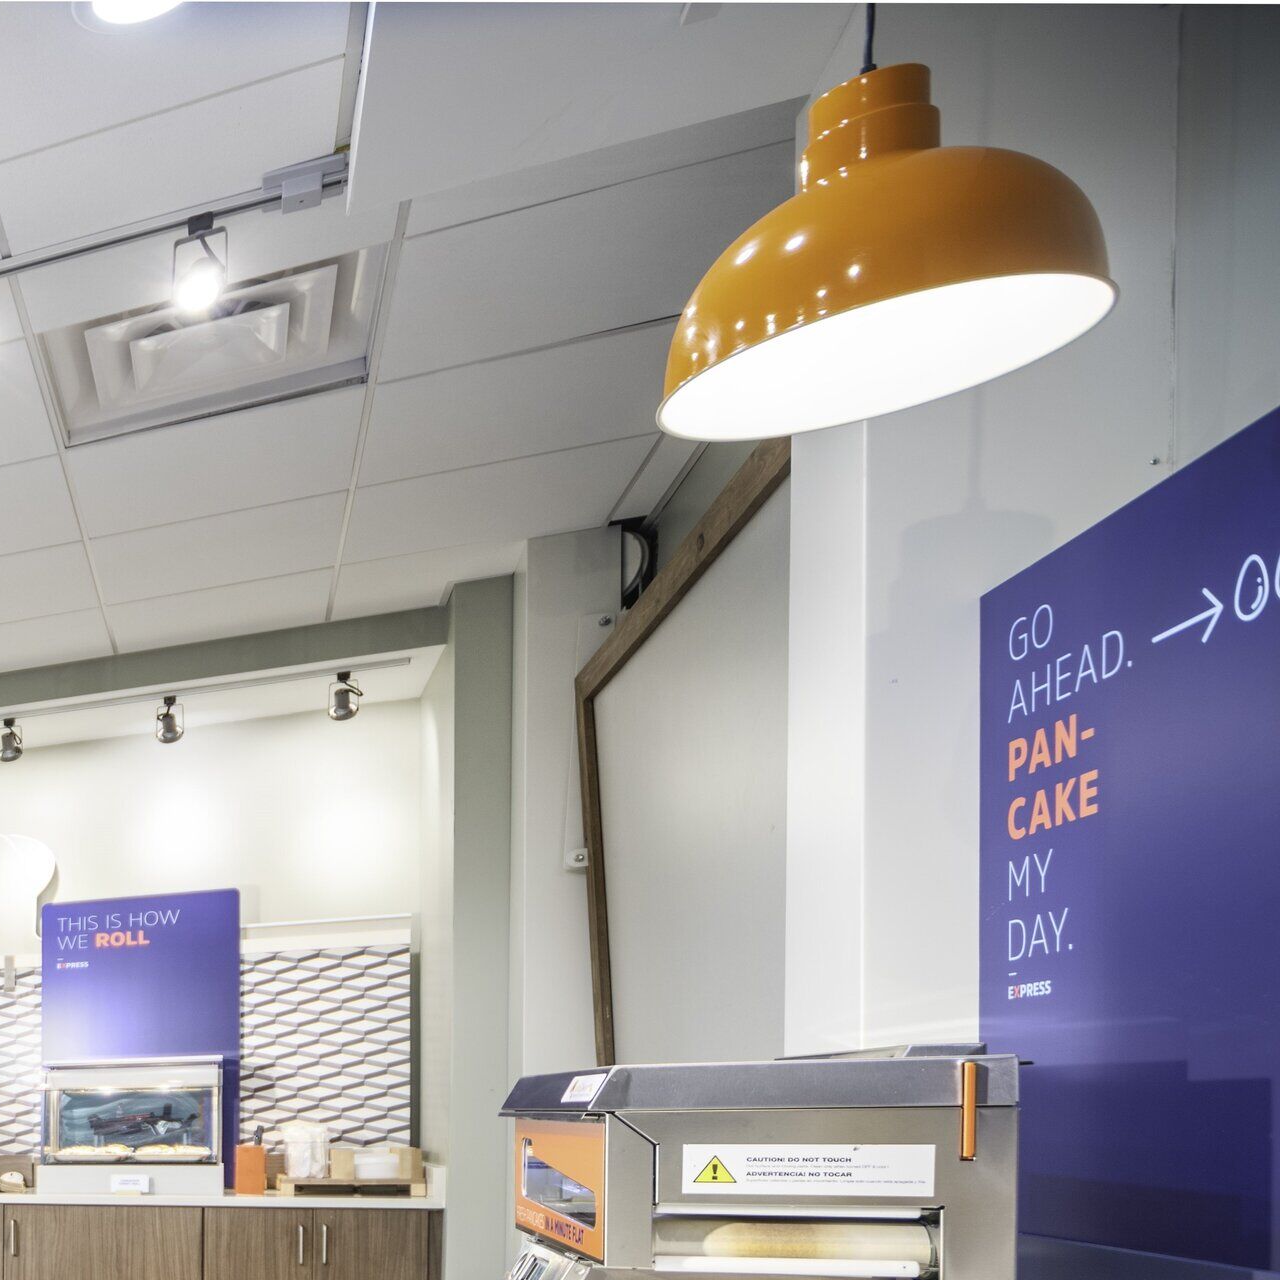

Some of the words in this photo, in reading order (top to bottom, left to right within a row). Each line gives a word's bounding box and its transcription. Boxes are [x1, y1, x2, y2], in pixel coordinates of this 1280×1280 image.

[1008, 604, 1053, 661] GO
[1007, 629, 1133, 724] AHEAD.
[1008, 713, 1096, 783] PAN-
[1007, 769, 1098, 840] CAKE
[1008, 848, 1053, 901] MY
[57, 915, 99, 933] THIS
[105, 913, 122, 929] IS
[129, 909, 181, 928] HOW
[57, 933, 89, 951] WE
[95, 930, 151, 948] ROLL
[1008, 907, 1073, 962] DAY.
[56, 961, 89, 970] EXPRESS
[1007, 979, 1052, 1000] EXPRESS
